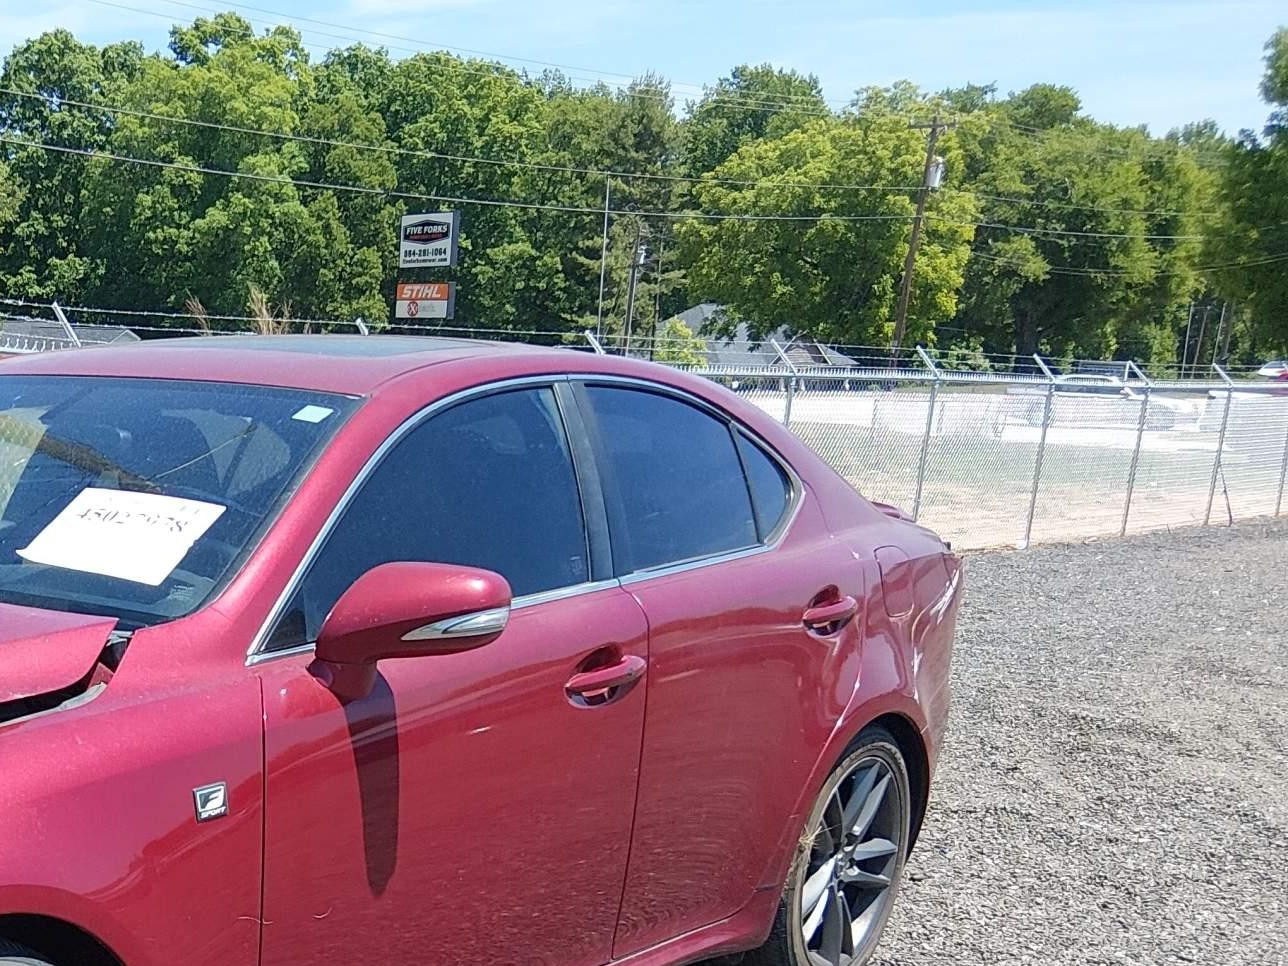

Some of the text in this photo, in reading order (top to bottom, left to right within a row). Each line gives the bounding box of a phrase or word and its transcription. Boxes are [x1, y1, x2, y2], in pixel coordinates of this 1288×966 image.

[406, 224, 448, 236] FIVE FORKS
[402, 285, 441, 299] STIHL
[200, 806, 227, 819] SPORT
